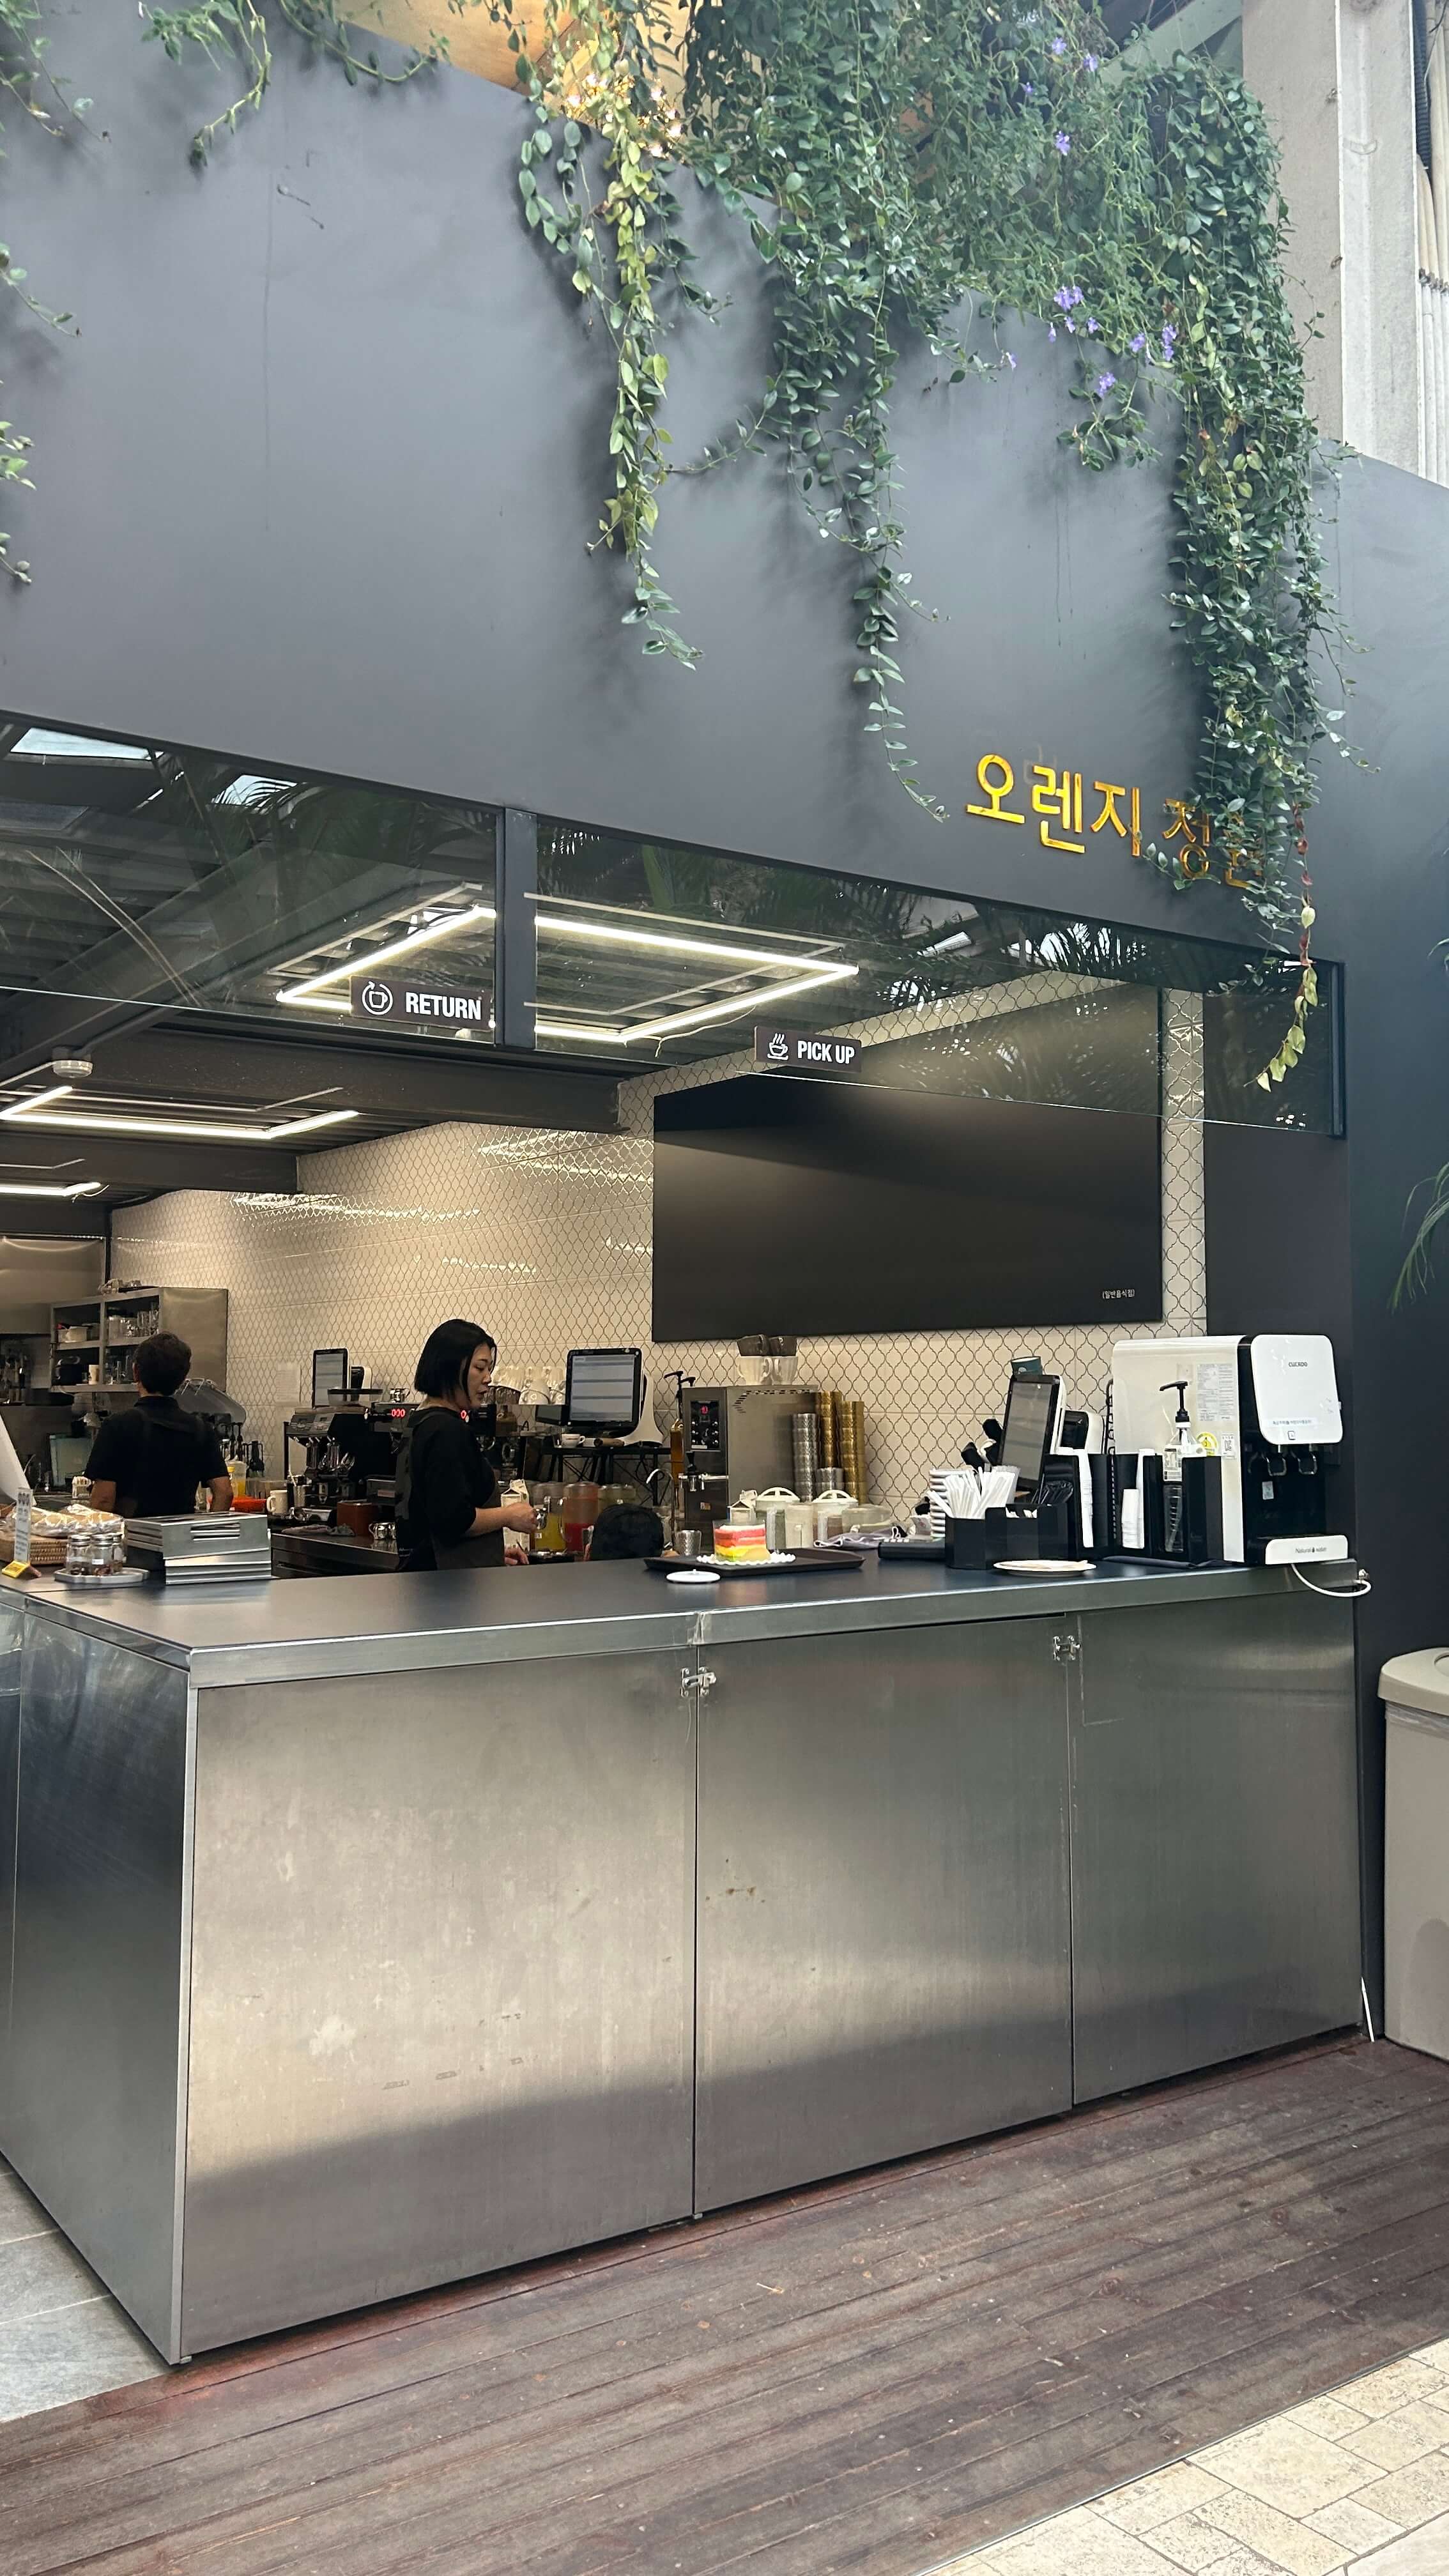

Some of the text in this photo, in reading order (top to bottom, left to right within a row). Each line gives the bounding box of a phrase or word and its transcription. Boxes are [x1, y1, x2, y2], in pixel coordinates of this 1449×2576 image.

[965, 753, 1141, 857] 오렌지
[406, 992, 482, 1020] RETURN
[797, 1039, 855, 1065] PICK UP
